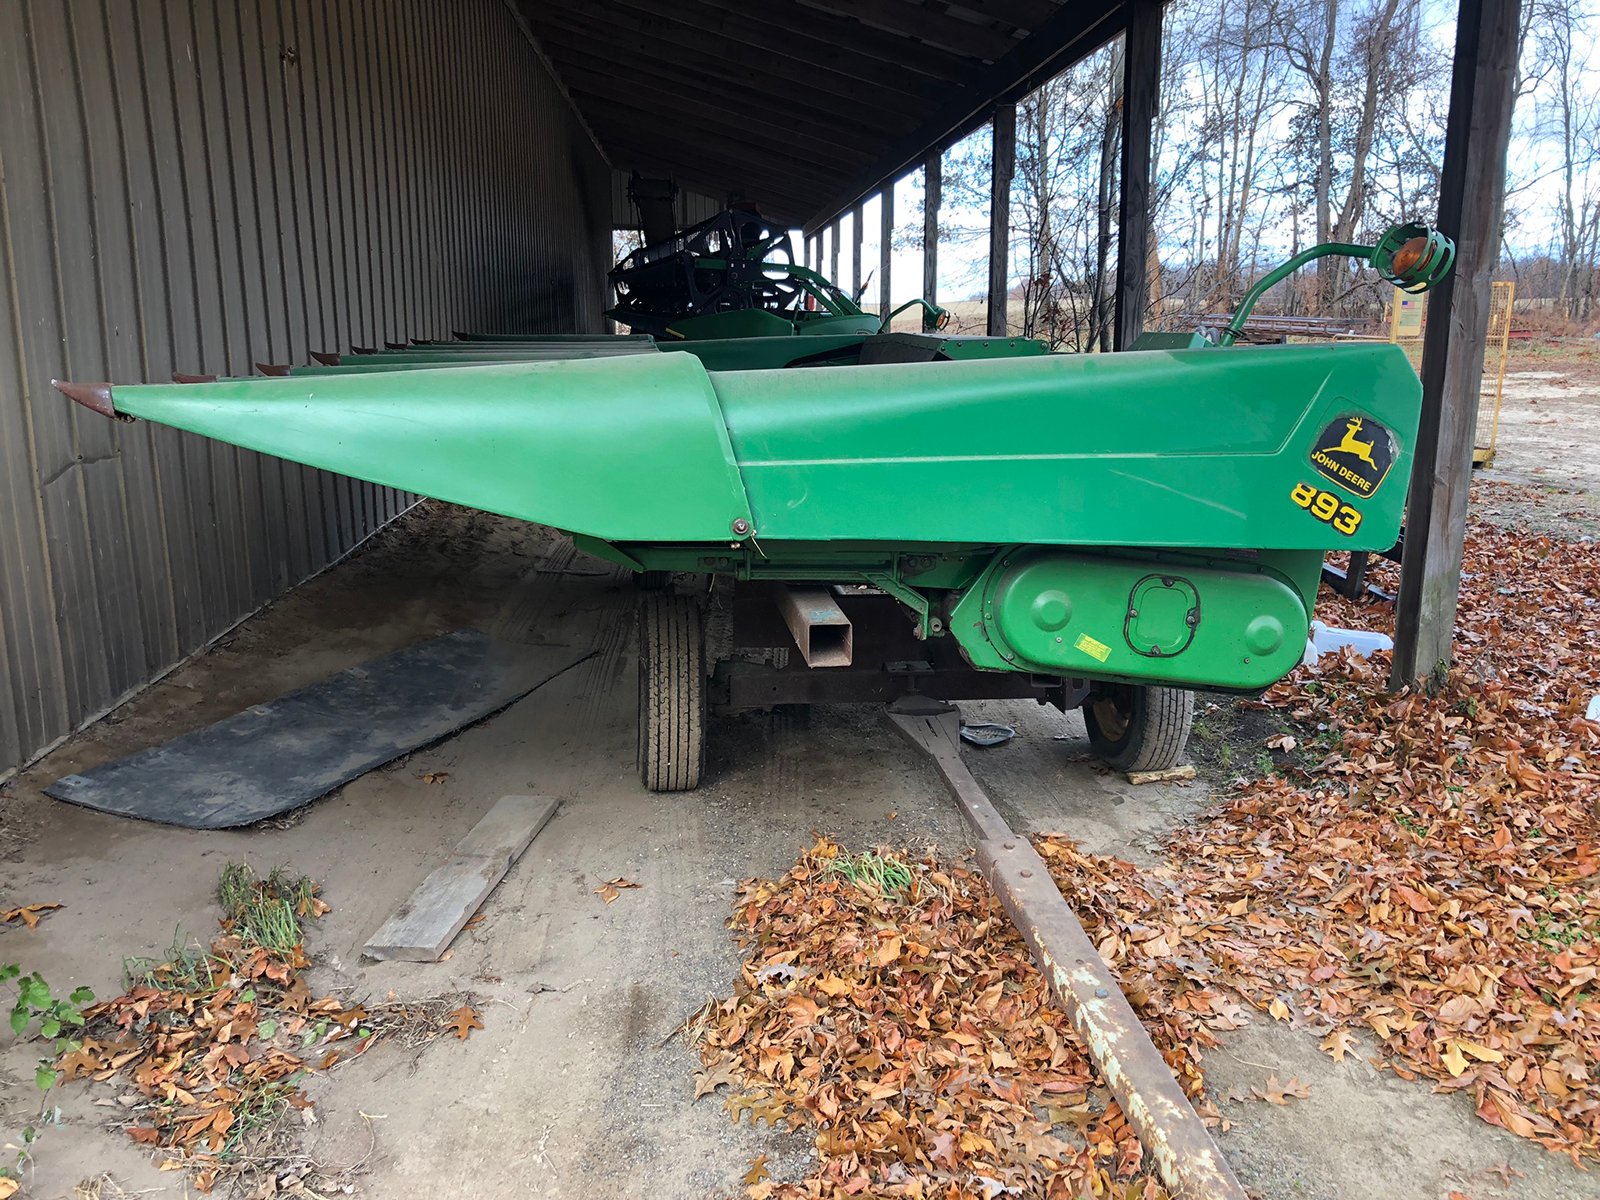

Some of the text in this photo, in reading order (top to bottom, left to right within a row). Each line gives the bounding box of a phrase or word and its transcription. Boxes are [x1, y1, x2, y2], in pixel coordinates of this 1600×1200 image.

[1311, 451, 1372, 492] JOHN DEERE
[1291, 482, 1363, 536] 893
